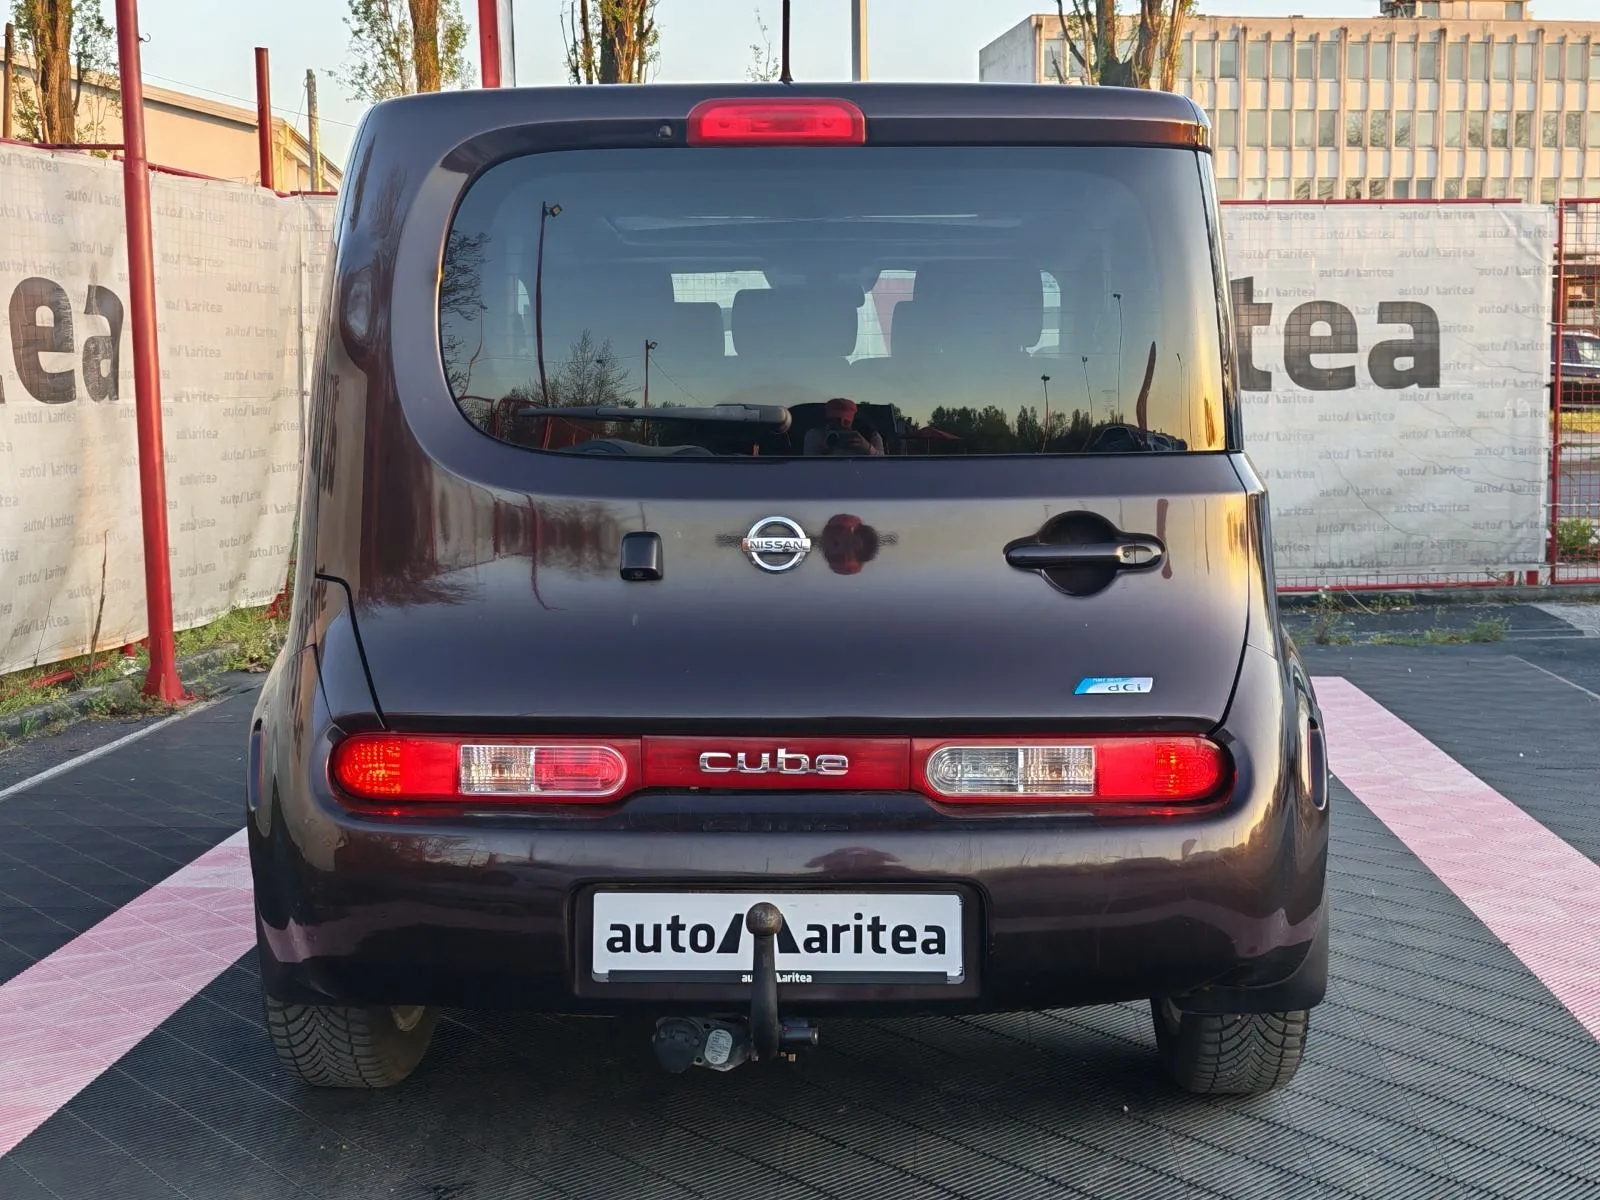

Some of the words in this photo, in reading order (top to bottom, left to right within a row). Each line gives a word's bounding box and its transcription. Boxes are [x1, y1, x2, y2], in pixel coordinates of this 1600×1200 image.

[0, 277, 124, 404] ea
[750, 540, 803, 550] NISSAN
[1107, 683, 1142, 692] dCi
[699, 748, 849, 775] cube
